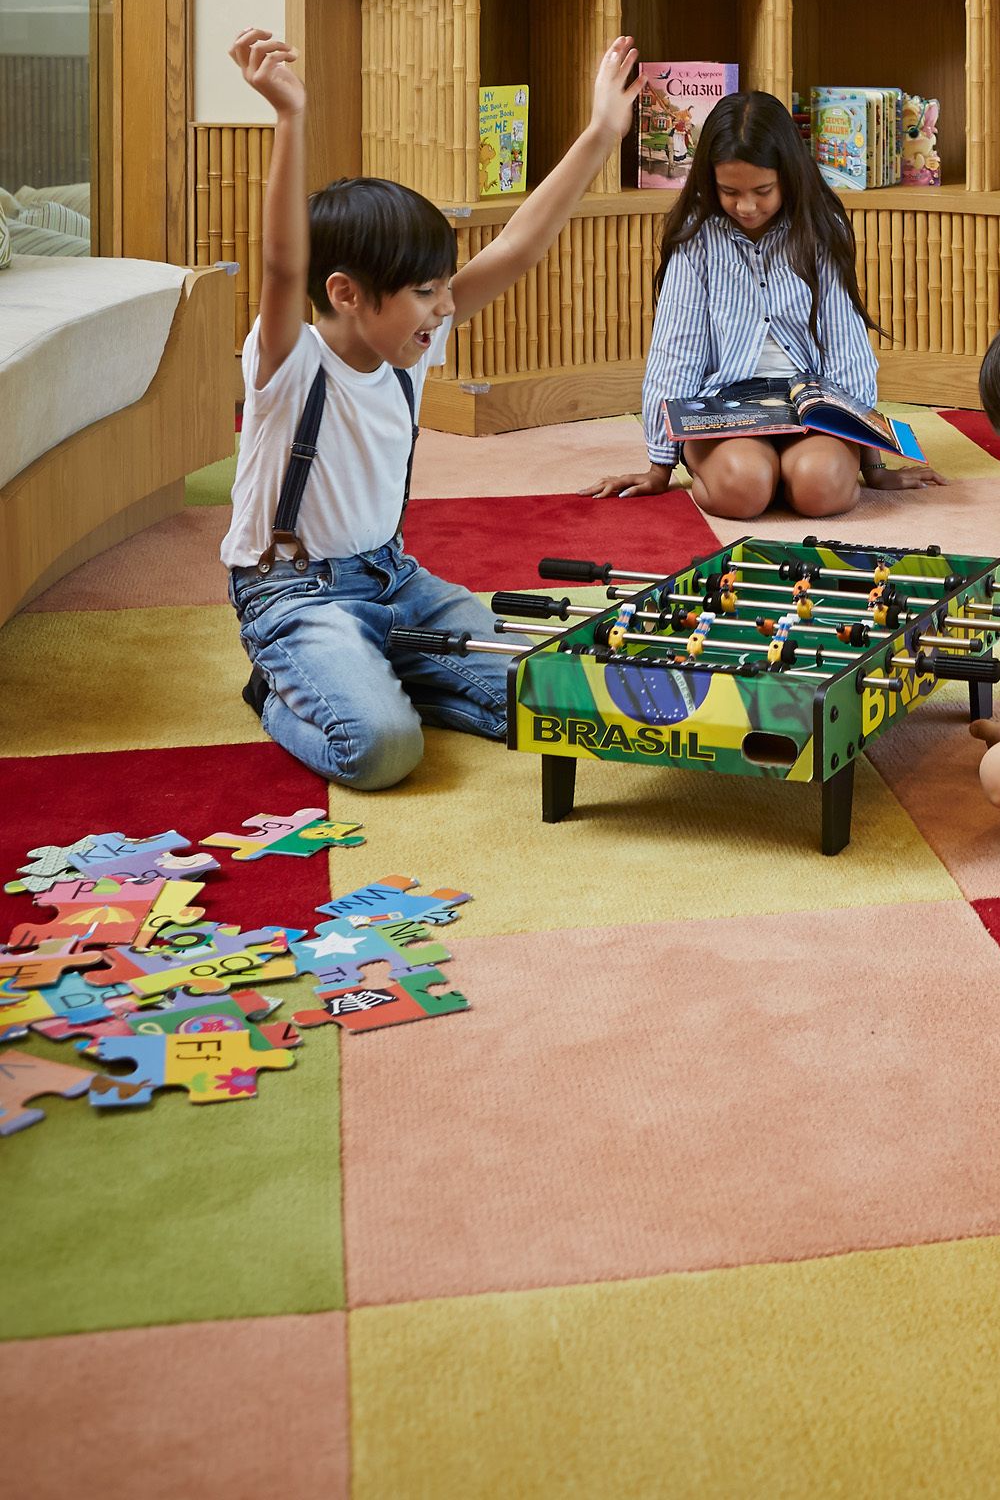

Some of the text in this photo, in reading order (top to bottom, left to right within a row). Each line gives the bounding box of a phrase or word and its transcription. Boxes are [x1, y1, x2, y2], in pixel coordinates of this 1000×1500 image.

[666, 78, 722, 97] Сказки
[494, 119, 508, 133] ME
[531, 715, 716, 761] BRASIL
[176, 1039, 222, 1061] Ff
